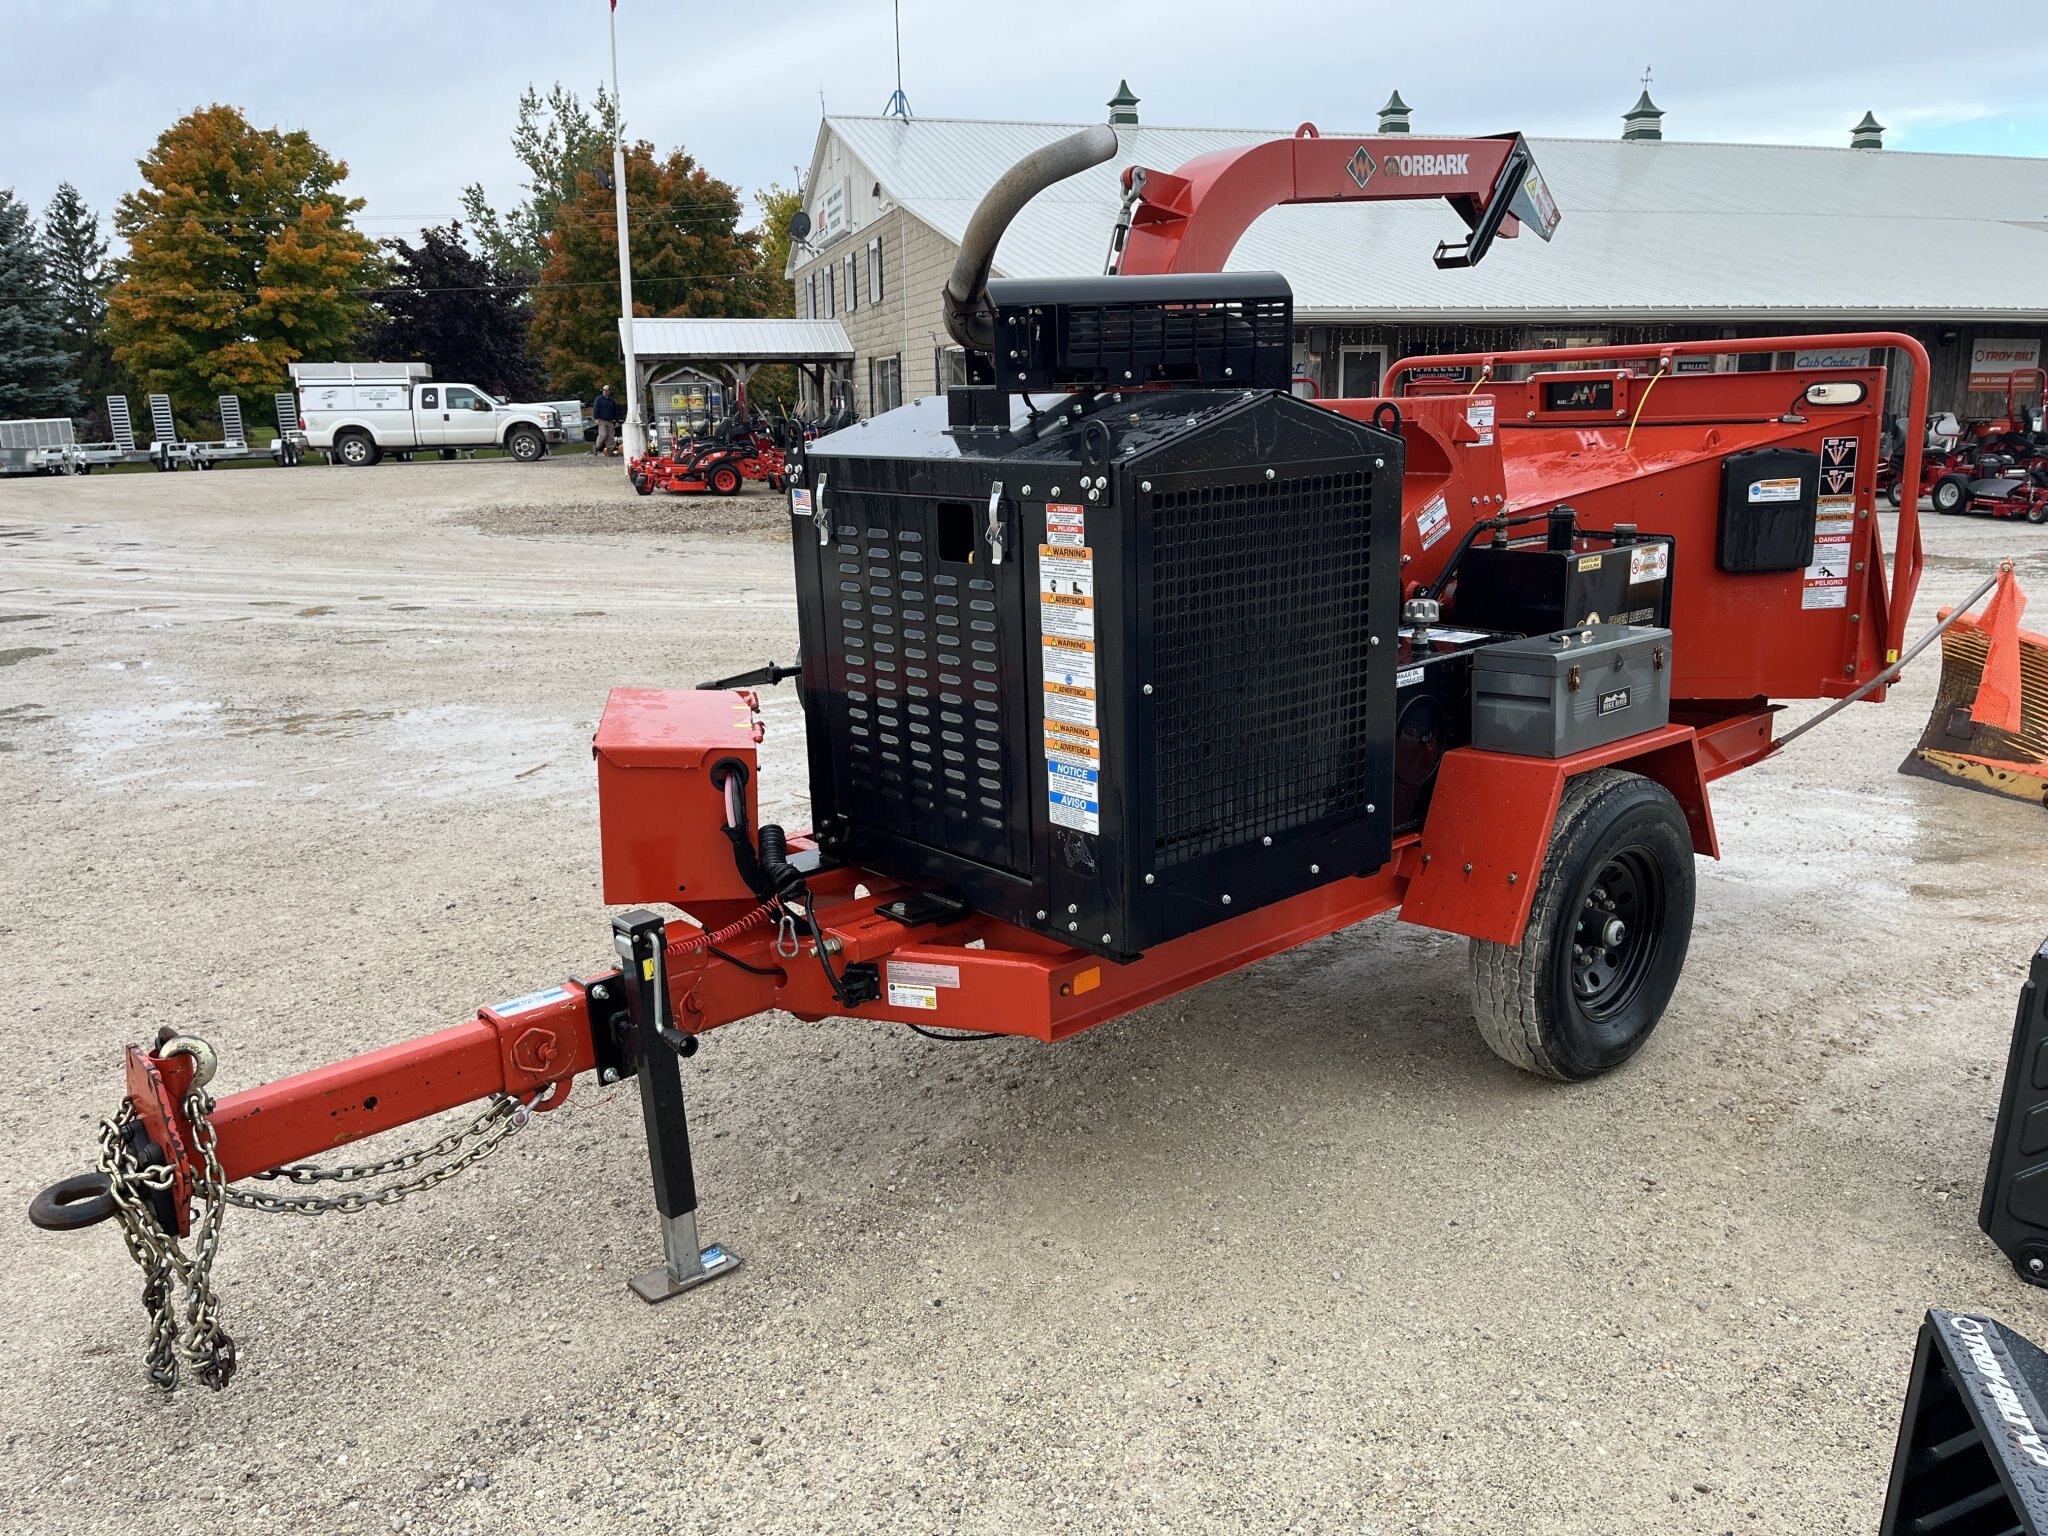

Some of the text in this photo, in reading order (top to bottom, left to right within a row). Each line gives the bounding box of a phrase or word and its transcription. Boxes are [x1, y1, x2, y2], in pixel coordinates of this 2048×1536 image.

[1796, 355, 1858, 368] Cub Cadet
[1985, 351, 2036, 361] TROY-BILT
[1625, 360, 1647, 368] CALLING
[1423, 494, 1440, 511] DANGER
[1056, 505, 1078, 513] DANGER
[1057, 525, 1078, 533] PELIGRO
[1428, 519, 1446, 536] PELIGRO
[1053, 547, 1087, 558] WARNING
[1055, 596, 1086, 606] ADVERTENCIA
[1056, 639, 1087, 650] WARNING
[1058, 686, 1087, 697] ADVERTENCIA
[1059, 724, 1090, 737] WARNING
[1060, 743, 1091, 756] ADVERTENCIA
[1056, 763, 1088, 779] NOTICE
[1060, 794, 1087, 810] AVISO
[1960, 1332, 2037, 1435] TROY-BILT
